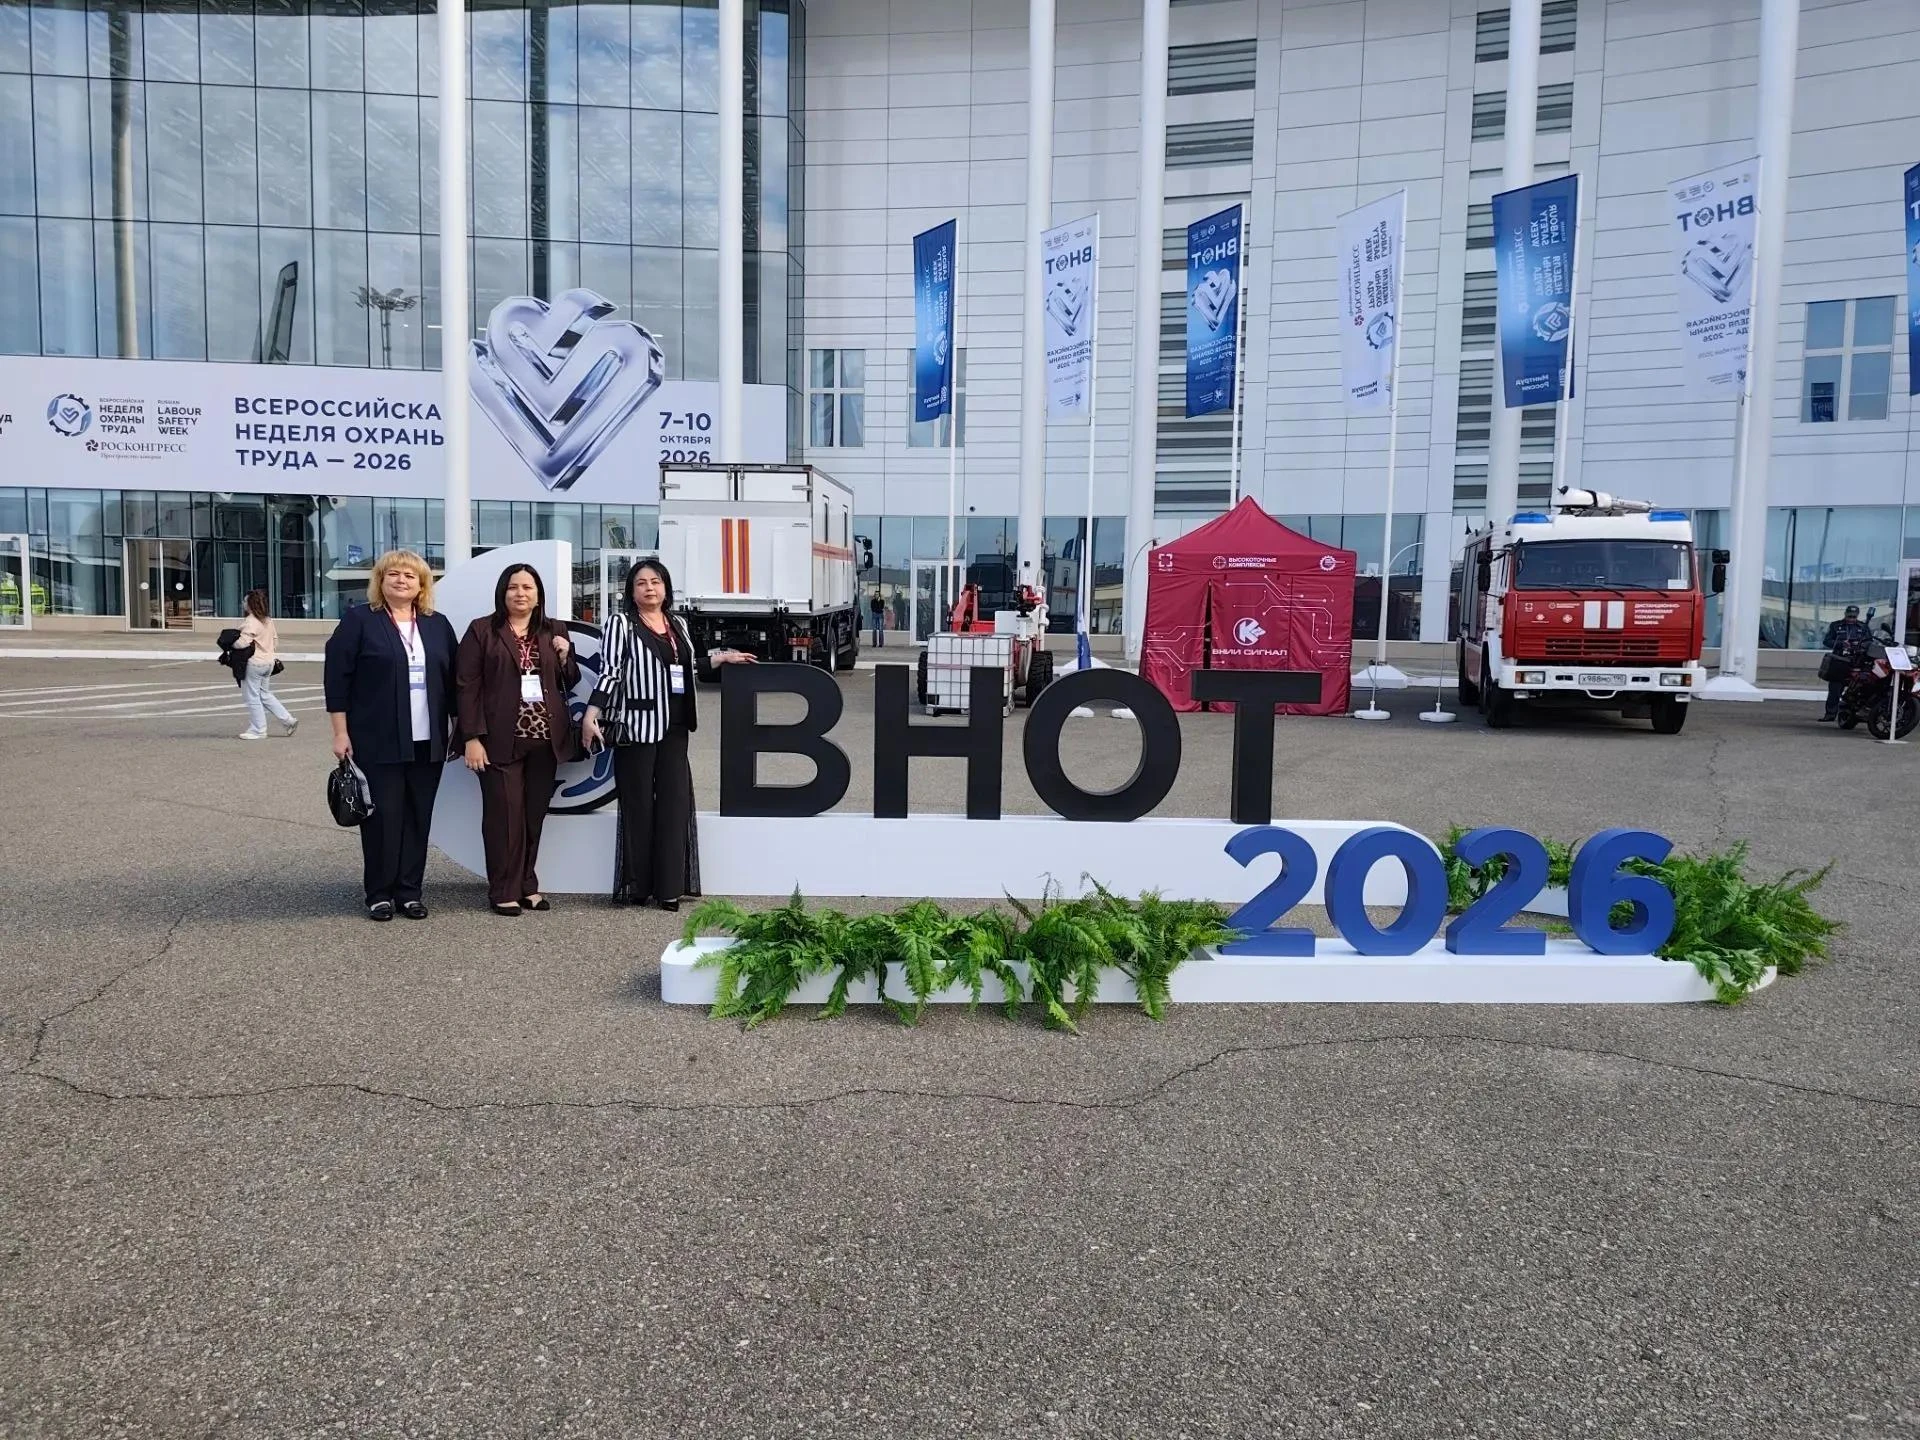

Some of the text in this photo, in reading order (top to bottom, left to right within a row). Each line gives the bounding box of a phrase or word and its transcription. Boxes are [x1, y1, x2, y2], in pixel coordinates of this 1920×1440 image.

[99, 405, 143, 415] НЕДЕЛЯ
[157, 407, 202, 416] LABOUR
[235, 397, 442, 420] ВСЕРОССИЙСКА
[99, 415, 145, 424] ОХРАНЫ
[157, 417, 198, 427] SAFETY
[100, 425, 136, 435] ТРУДА
[158, 427, 189, 436] WEEK
[235, 423, 336, 444] НЕДЕЛЯ
[659, 435, 711, 444] ОКТЯБРЯ
[100, 442, 187, 453] РОСКОНГРЕСС
[236, 449, 319, 470] ТРУДА
[353, 453, 412, 471] 2026
[660, 449, 711, 465] 2026
[719, 663, 1322, 824] ВНОТ
[1218, 826, 1675, 957] 2026
